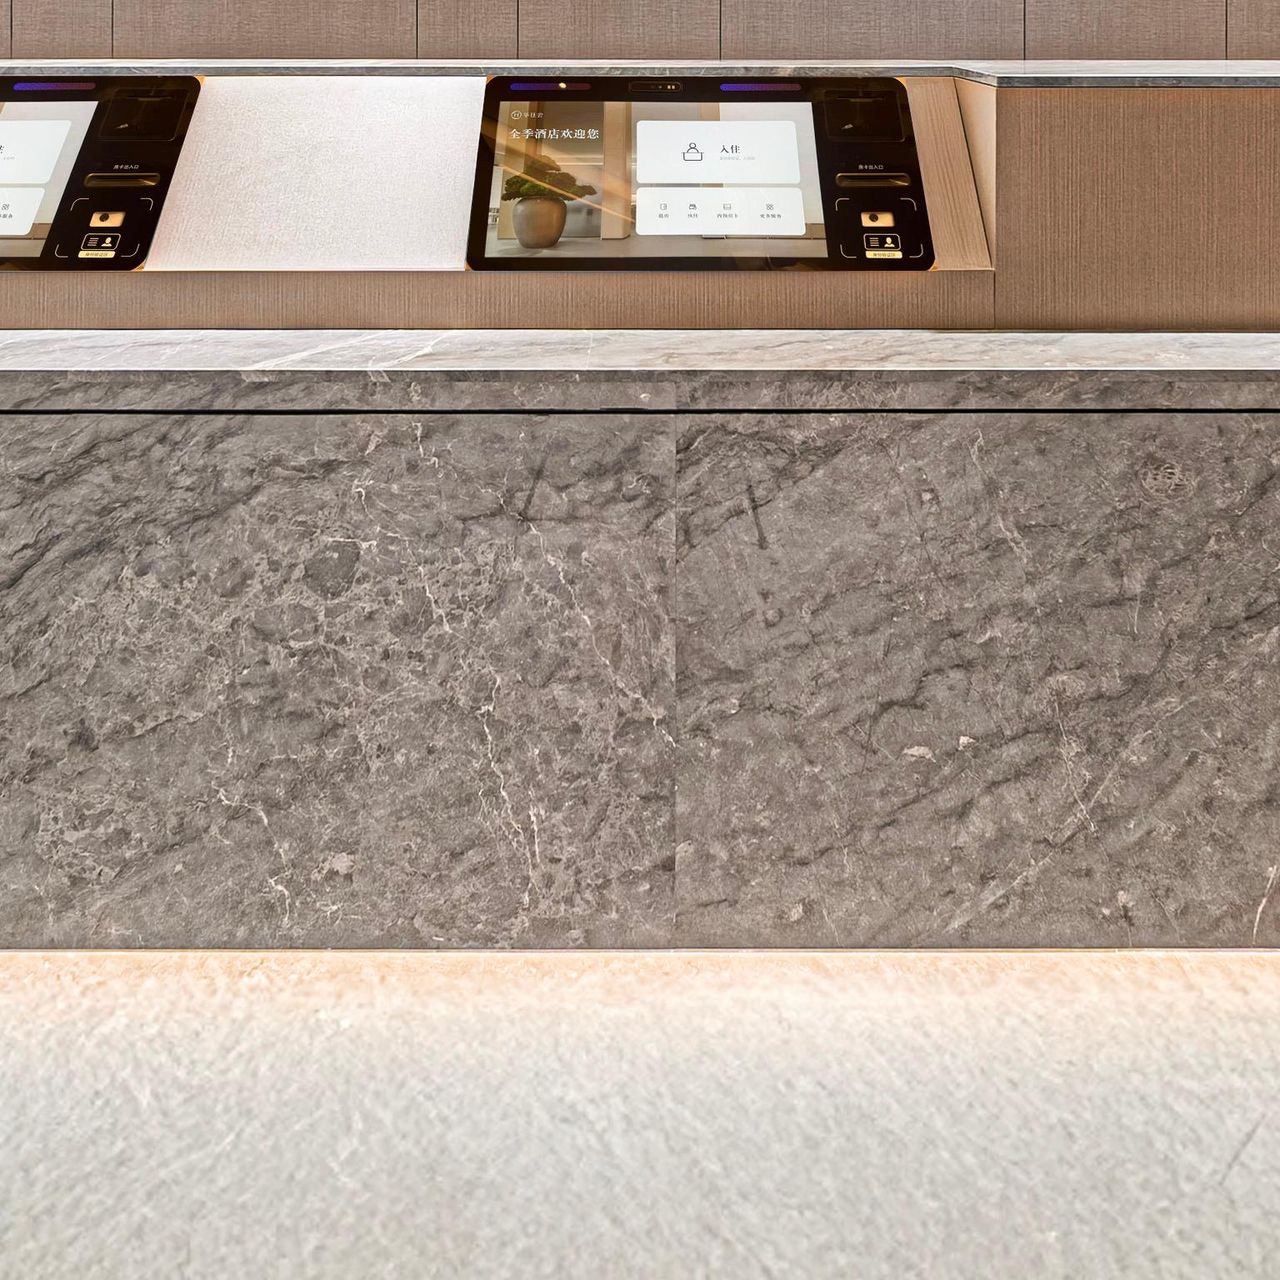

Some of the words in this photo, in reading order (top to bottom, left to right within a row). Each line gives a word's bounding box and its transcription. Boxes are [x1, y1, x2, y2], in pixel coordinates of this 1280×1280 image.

[509, 128, 600, 139] 全季酒店欢迎您
